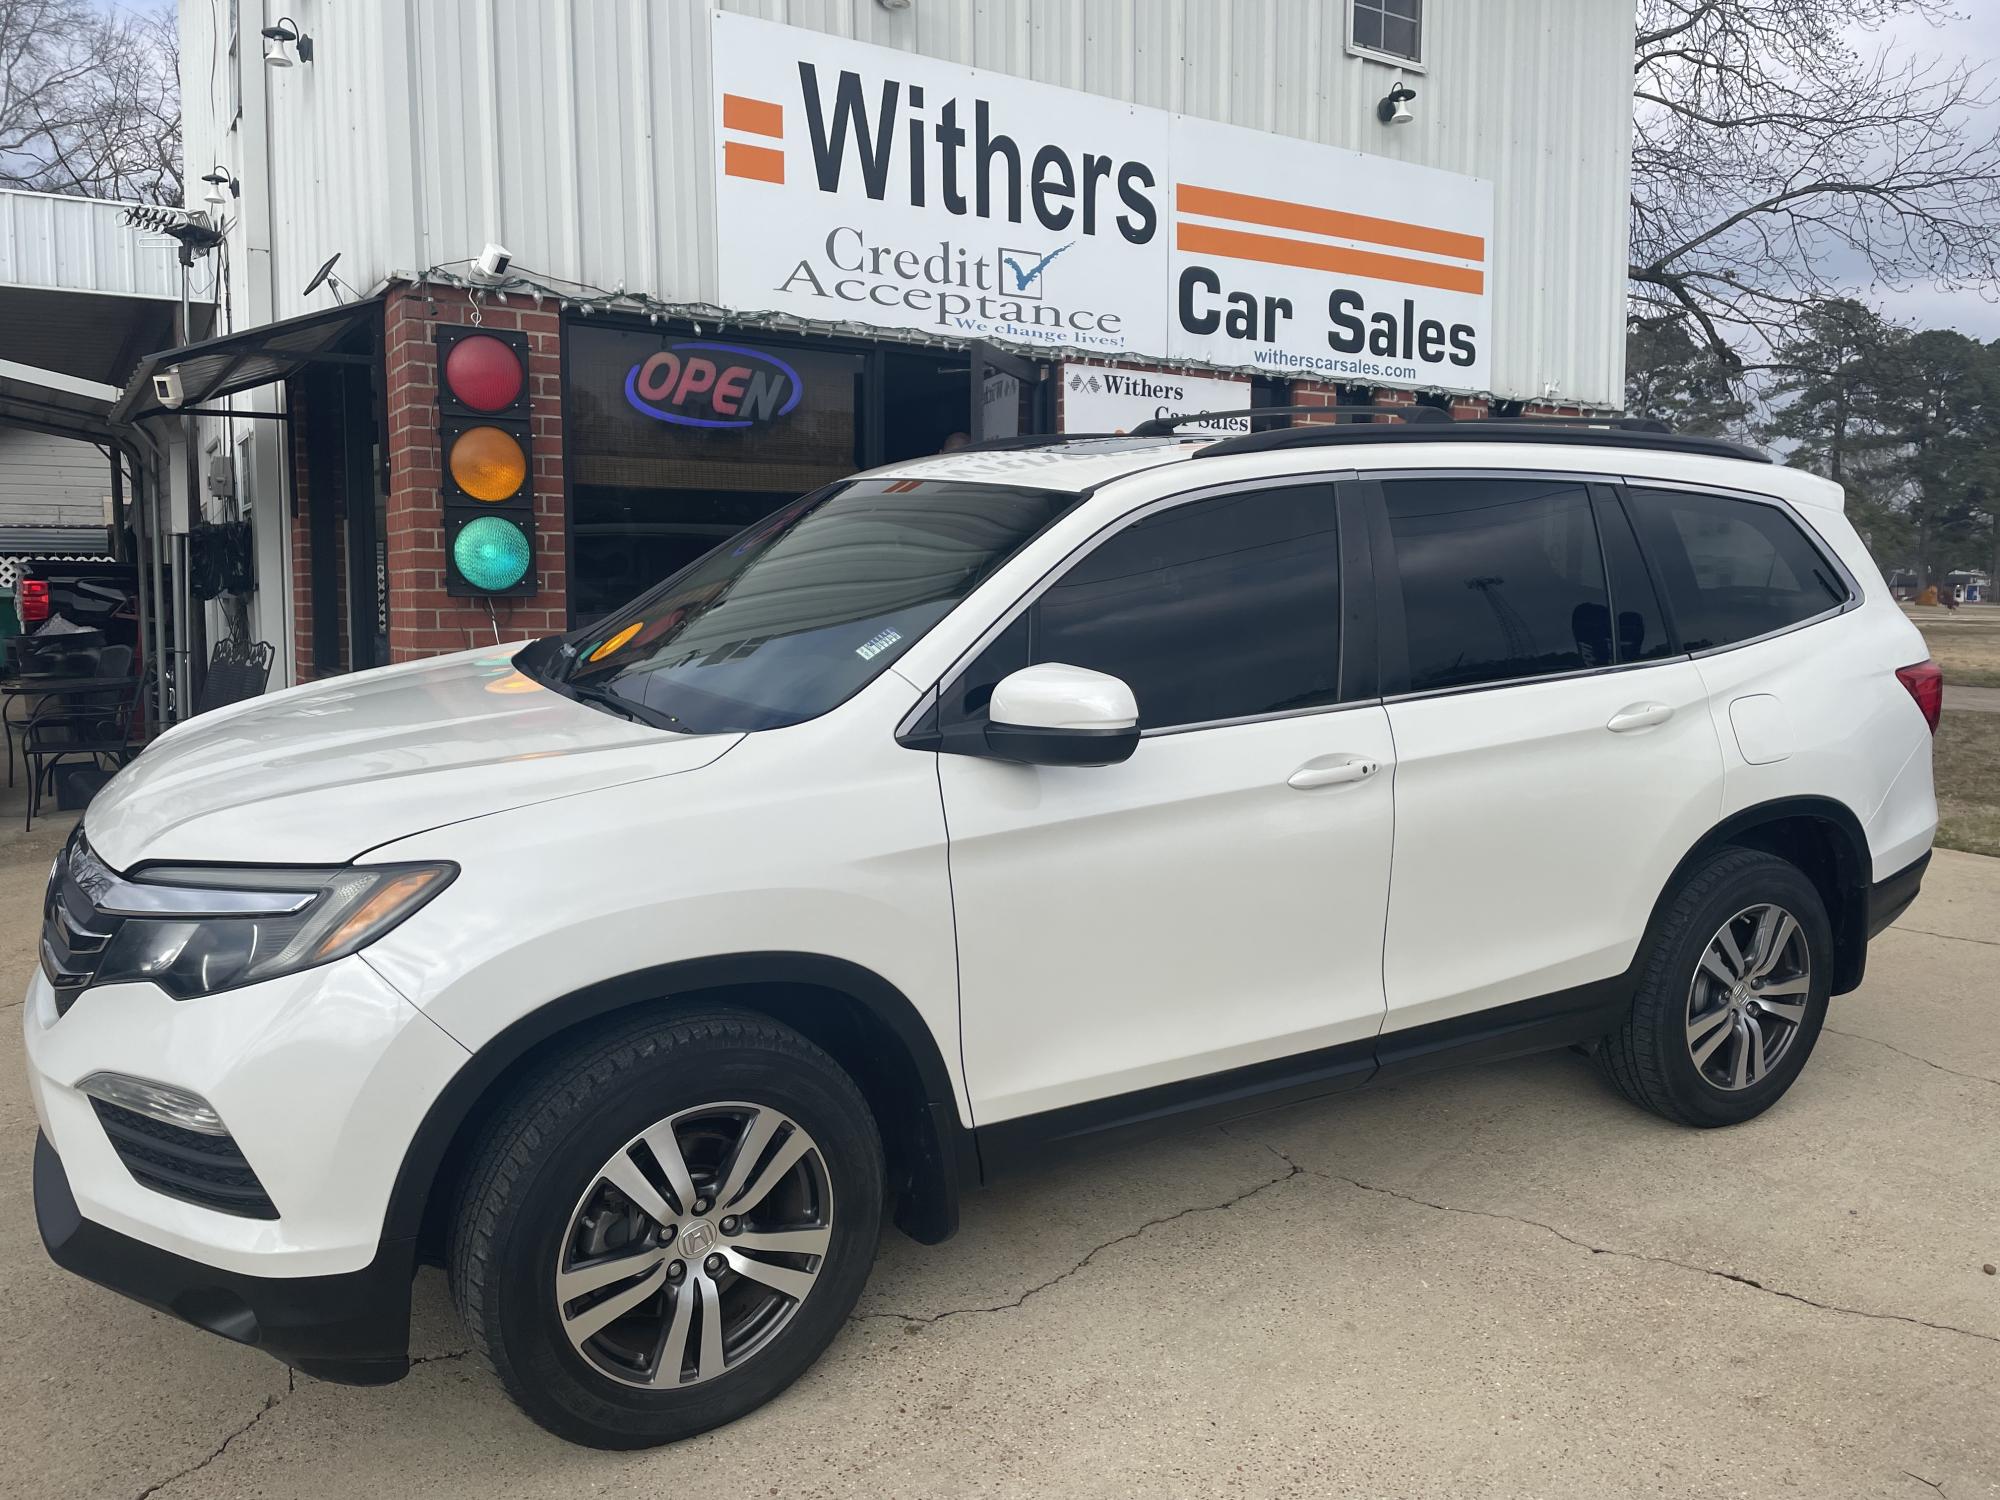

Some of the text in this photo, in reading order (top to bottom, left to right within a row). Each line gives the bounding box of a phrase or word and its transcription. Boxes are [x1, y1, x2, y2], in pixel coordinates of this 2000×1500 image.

[797, 61, 1157, 244] Withers
[825, 227, 992, 291] Credit
[773, 260, 1122, 334] Acceptance
[1178, 266, 1477, 367] Car Sales
[955, 317, 1126, 348] We change lives!
[1254, 350, 1417, 379] witherscarsales.com
[637, 352, 785, 421] OPEN
[1104, 374, 1184, 400] Withers
[1198, 410, 1249, 431] Sales
